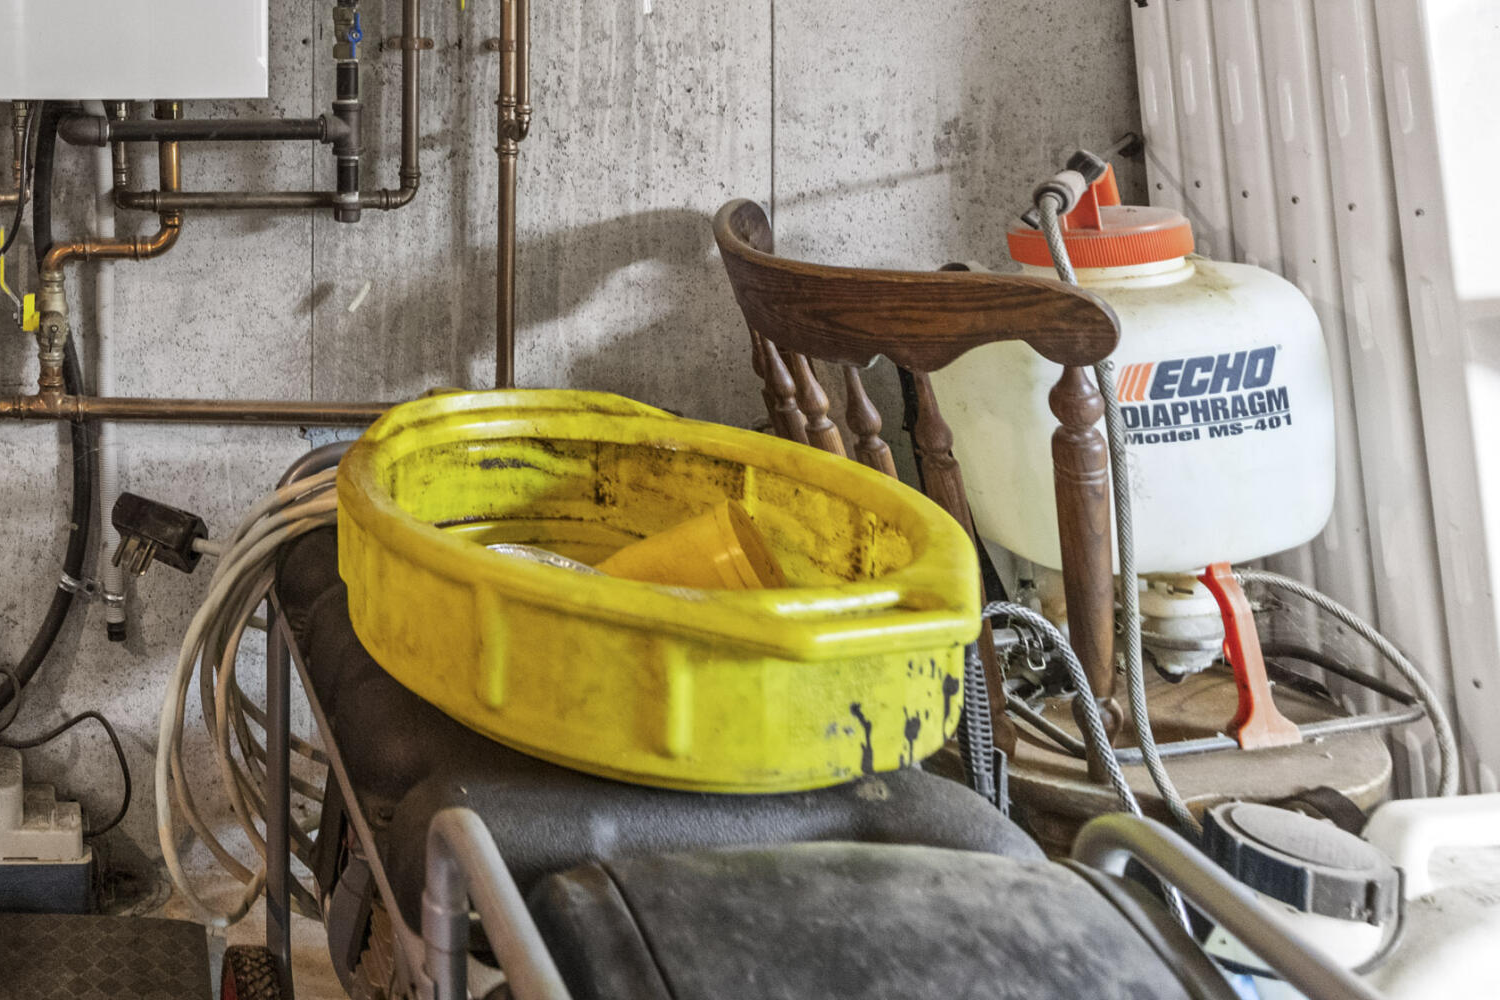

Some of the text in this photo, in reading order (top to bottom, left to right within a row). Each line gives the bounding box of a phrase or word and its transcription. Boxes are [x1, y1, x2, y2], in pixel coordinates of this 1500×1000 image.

[1150, 346, 1276, 400] ECHO
[1120, 386, 1290, 429] DIAPHRAGM
[1124, 413, 1292, 445] Model MS-401
